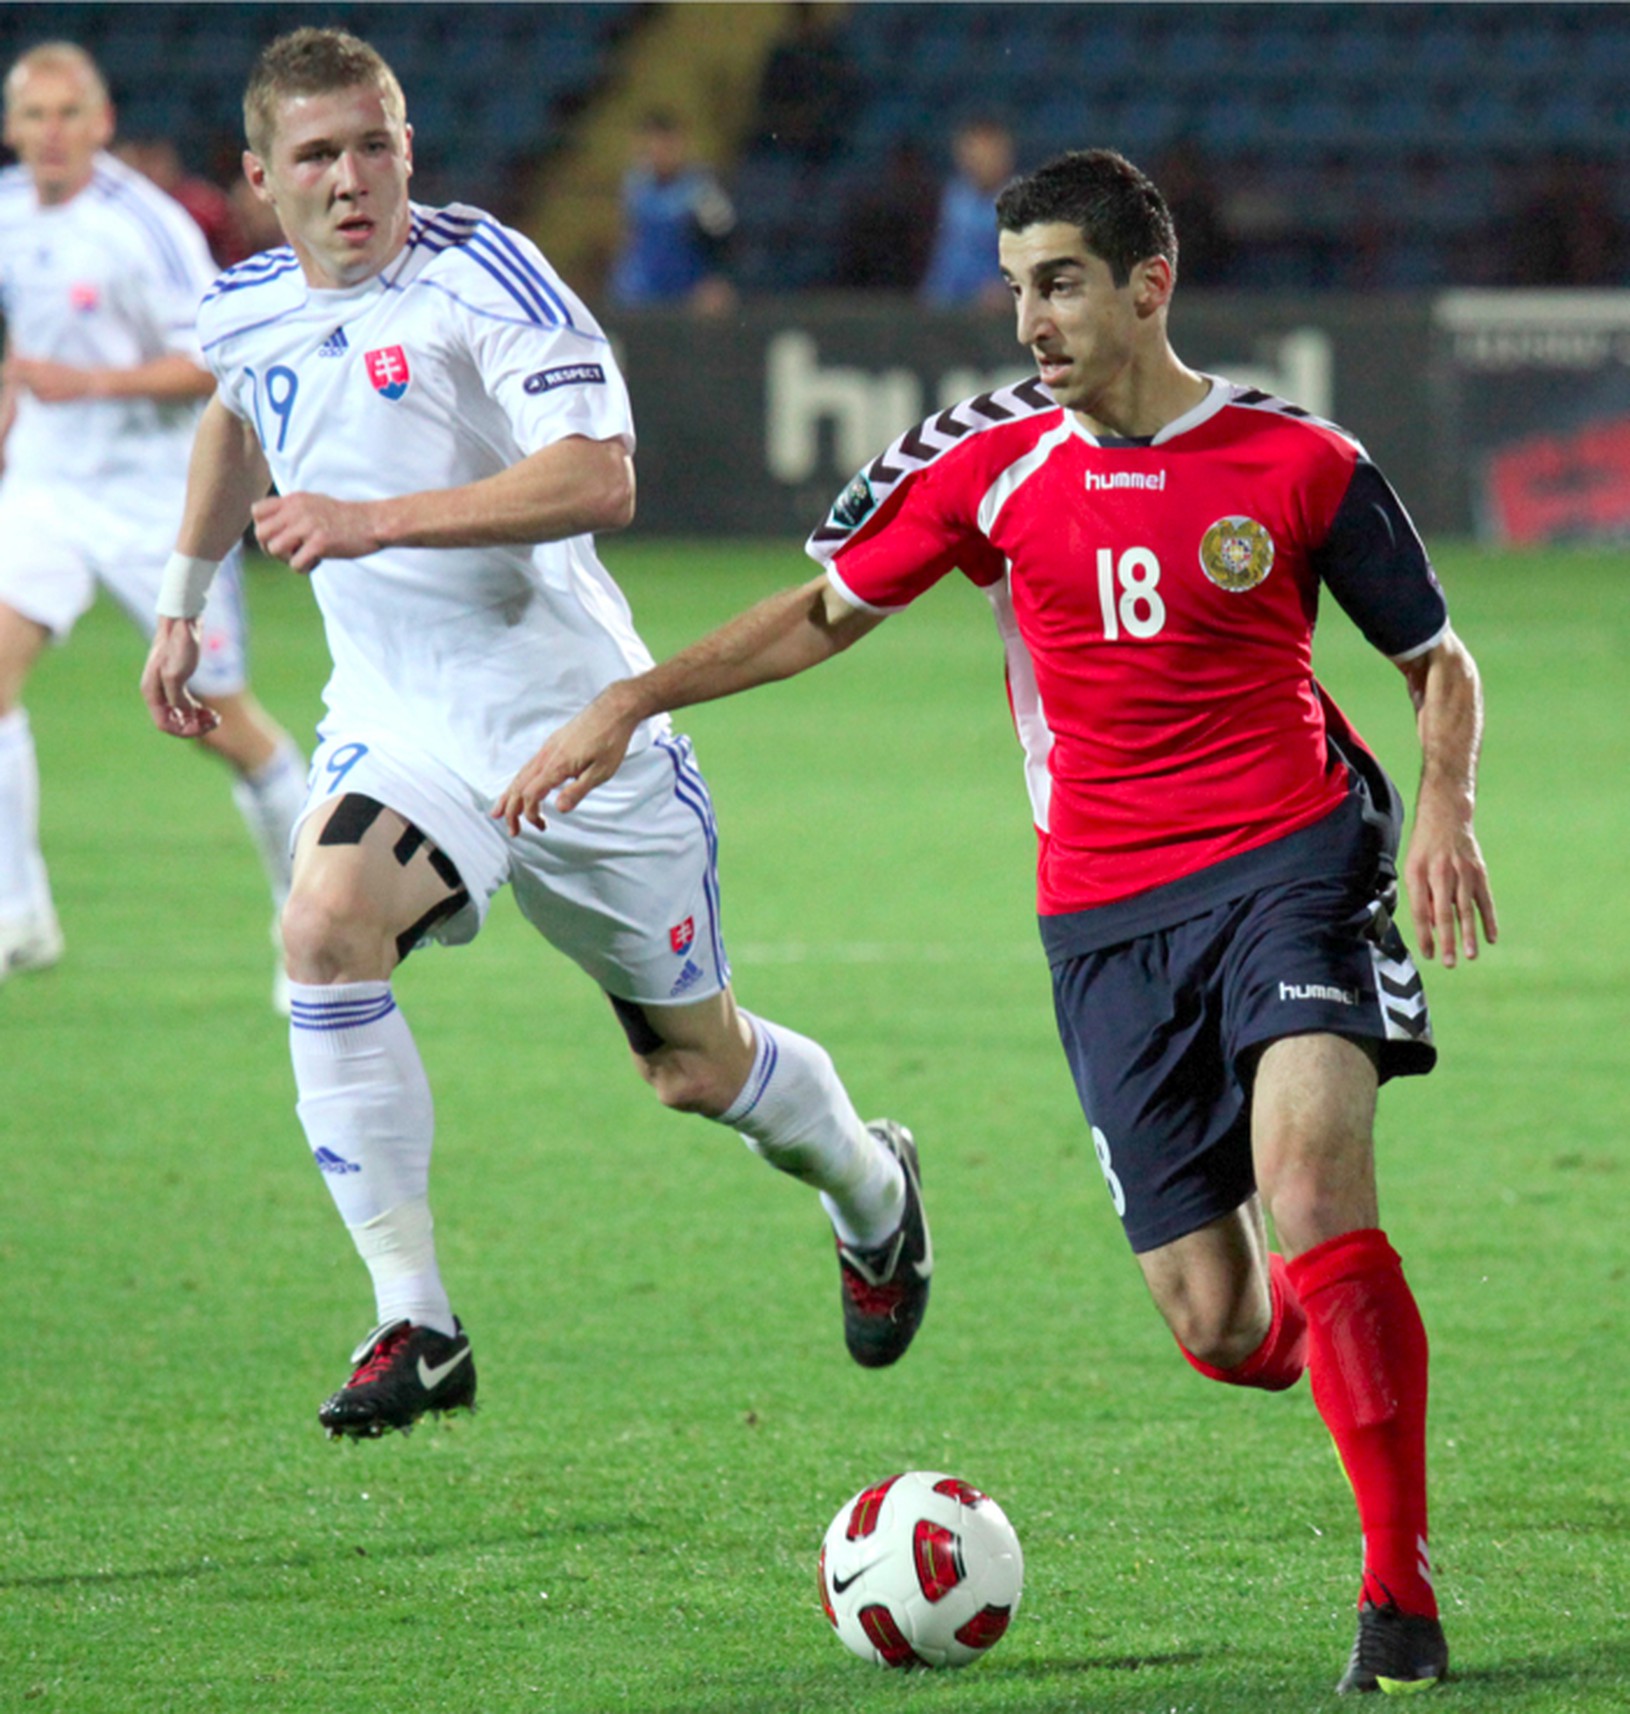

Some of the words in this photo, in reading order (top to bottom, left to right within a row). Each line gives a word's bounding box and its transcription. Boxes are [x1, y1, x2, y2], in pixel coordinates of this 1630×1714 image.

[545, 366, 602, 385] RESPECT
[242, 365, 298, 452] 19
[1084, 468, 1166, 491] hummel
[1096, 546, 1166, 641] 18
